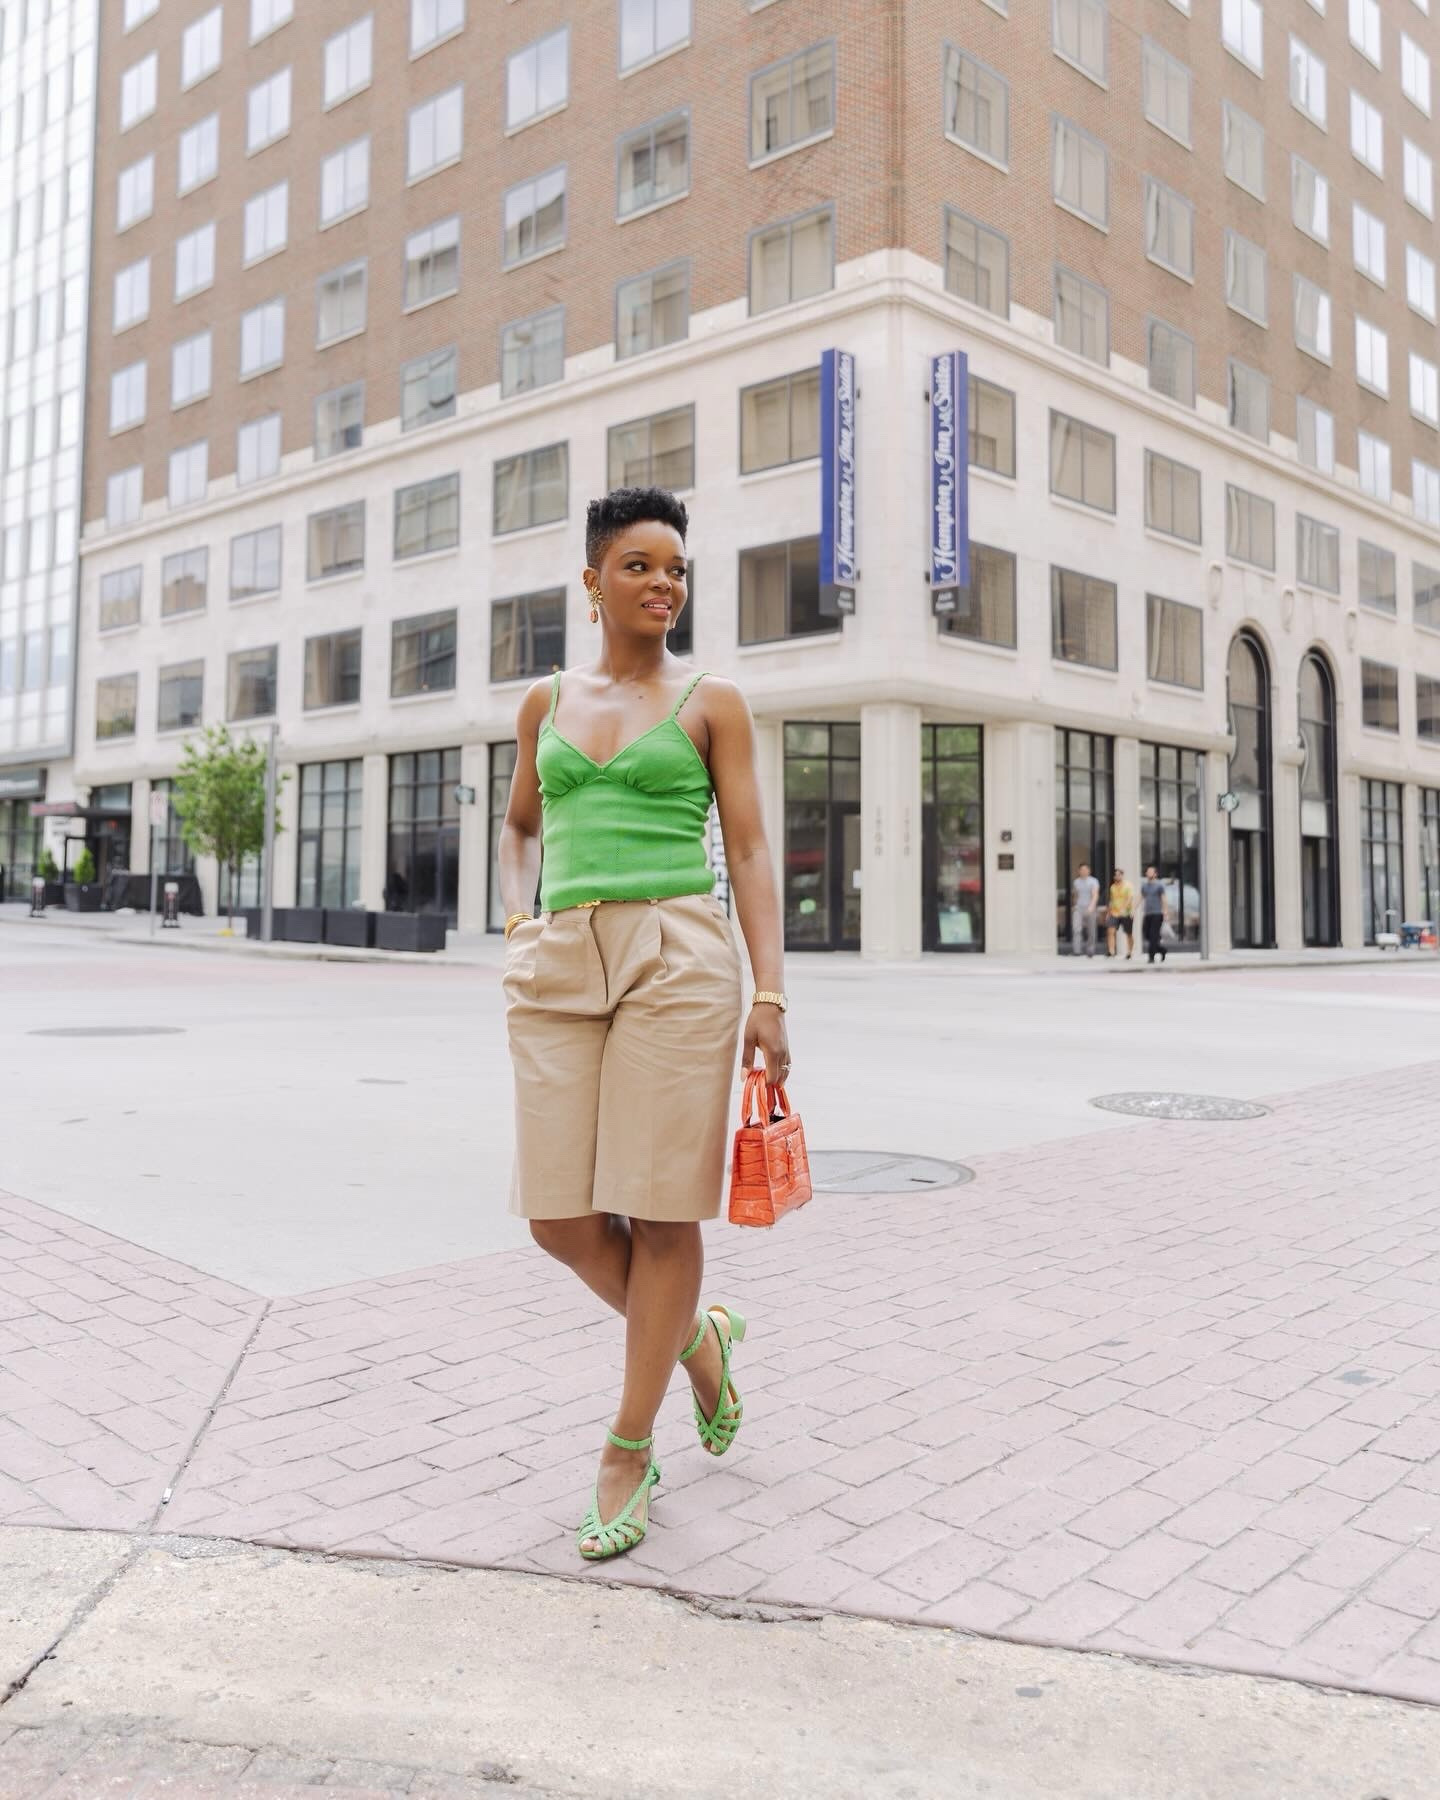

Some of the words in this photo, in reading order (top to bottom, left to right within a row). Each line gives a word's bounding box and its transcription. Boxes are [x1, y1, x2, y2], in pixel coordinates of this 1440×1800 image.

[838, 354, 853, 406] Suites
[933, 355, 953, 410] Suites
[838, 424, 854, 474] Inn
[934, 425, 954, 474] Inn
[837, 476, 854, 578] Hampton
[933, 476, 955, 579] Hampton
